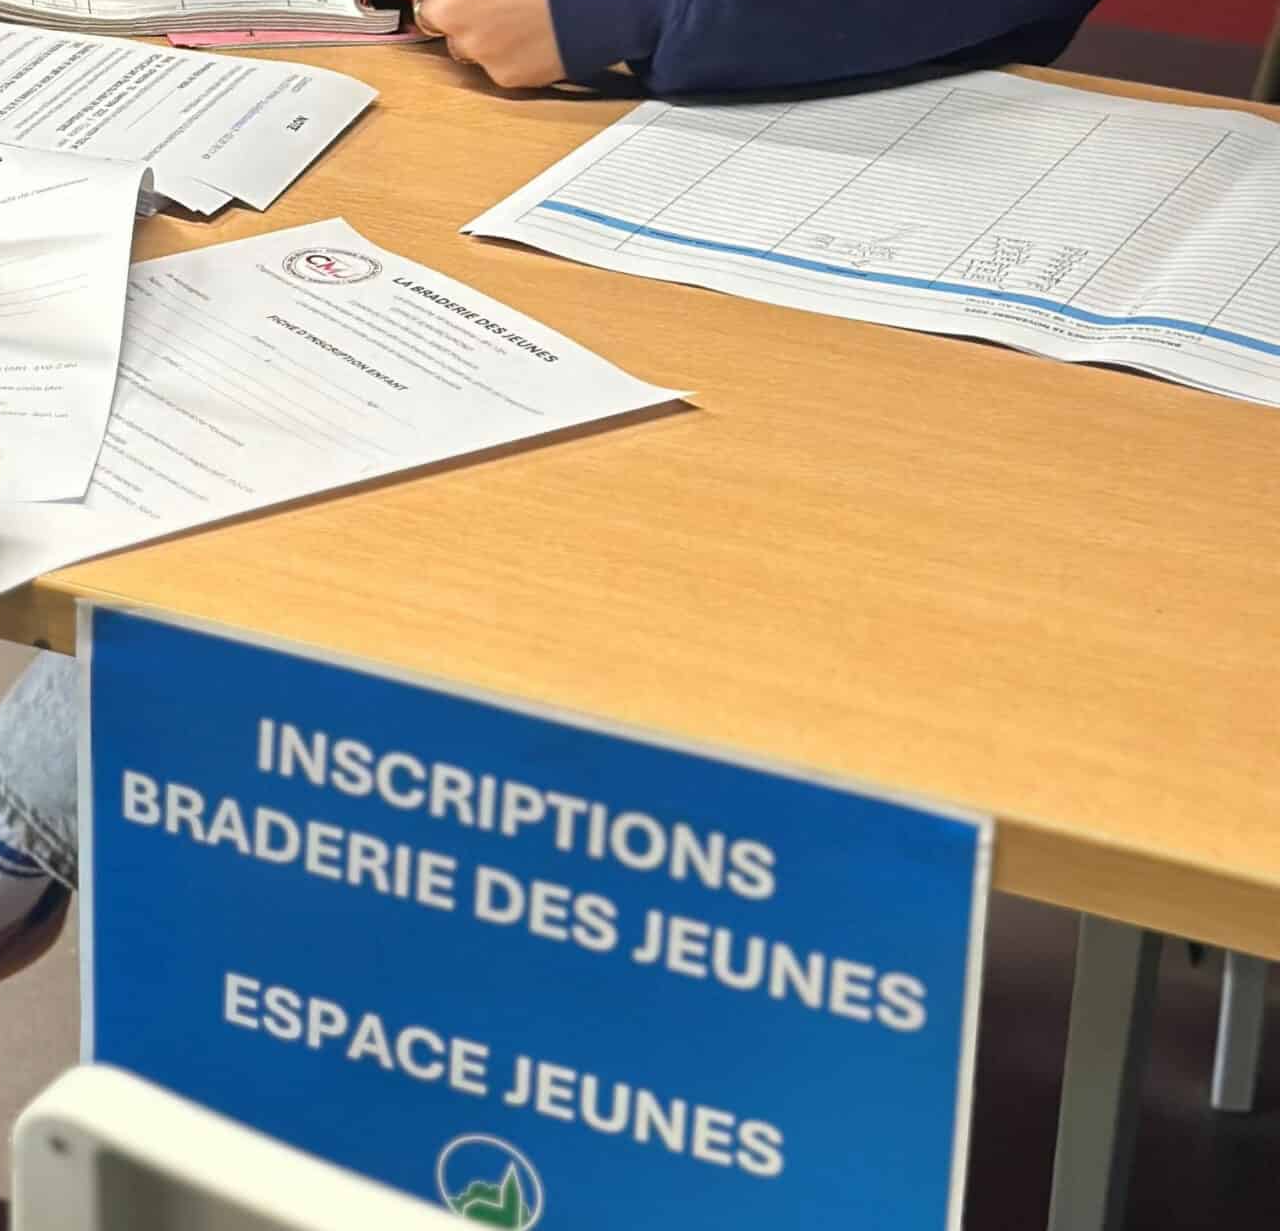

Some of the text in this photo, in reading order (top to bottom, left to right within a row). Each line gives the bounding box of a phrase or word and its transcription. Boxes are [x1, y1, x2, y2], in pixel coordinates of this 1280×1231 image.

[392, 276, 559, 363] LA BRADERIE DES JEUNES
[121, 769, 929, 1033] BRADERIE DES JEUNES
[257, 718, 777, 900] INSCRIPTIONS
[222, 972, 786, 1178] ESPACE JEUNES
